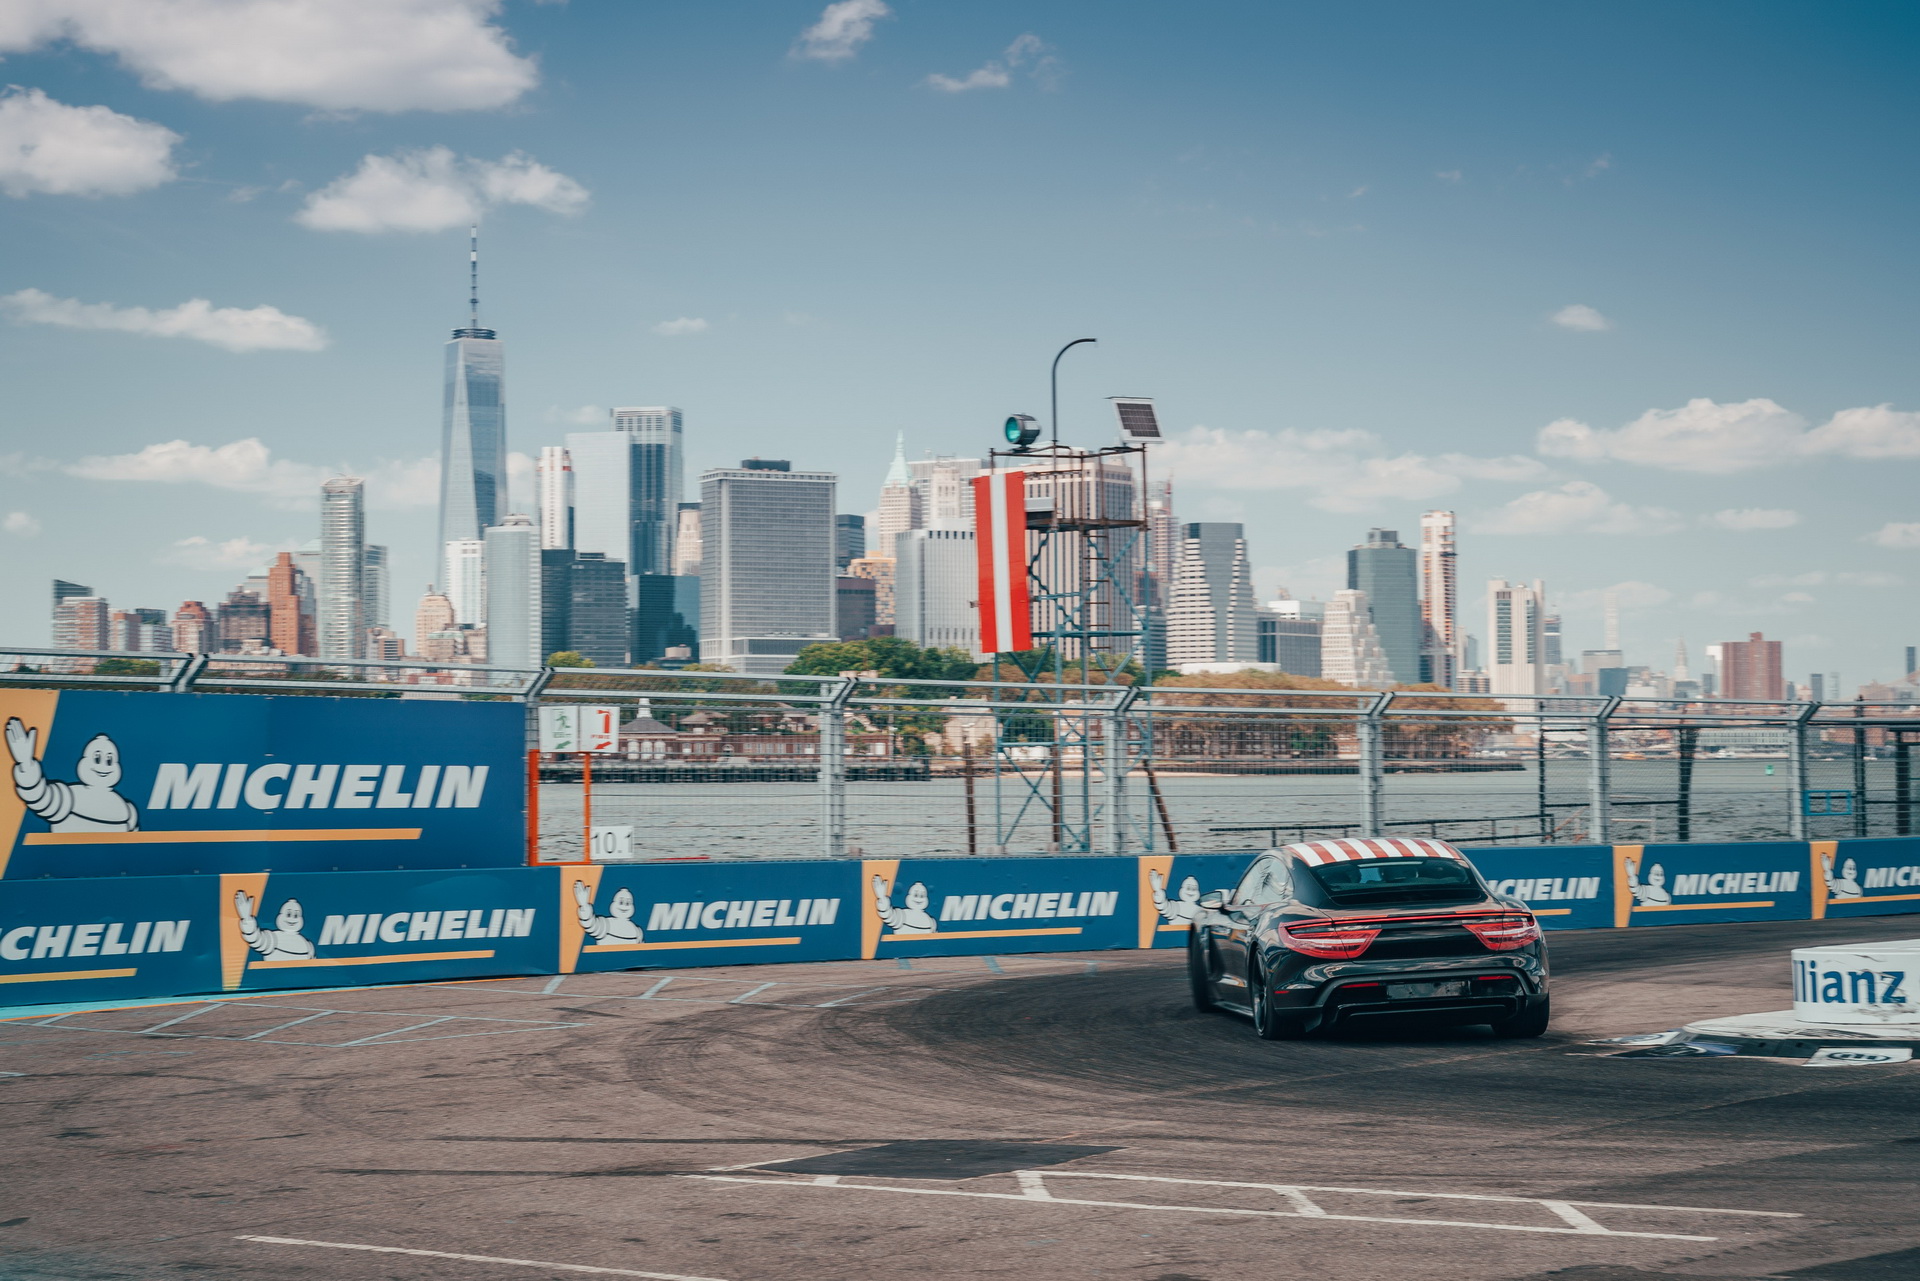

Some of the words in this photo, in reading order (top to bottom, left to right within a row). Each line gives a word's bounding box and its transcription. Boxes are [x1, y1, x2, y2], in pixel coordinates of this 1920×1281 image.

[146, 763, 490, 810] MICHELIN
[591, 831, 633, 855] 10.1
[1672, 871, 1800, 896] MICHELIN
[646, 898, 841, 931] MICHELIN
[939, 891, 1119, 921] MICHELIN
[0, 919, 192, 961] CHELIN
[317, 908, 536, 946] MICHELIN
